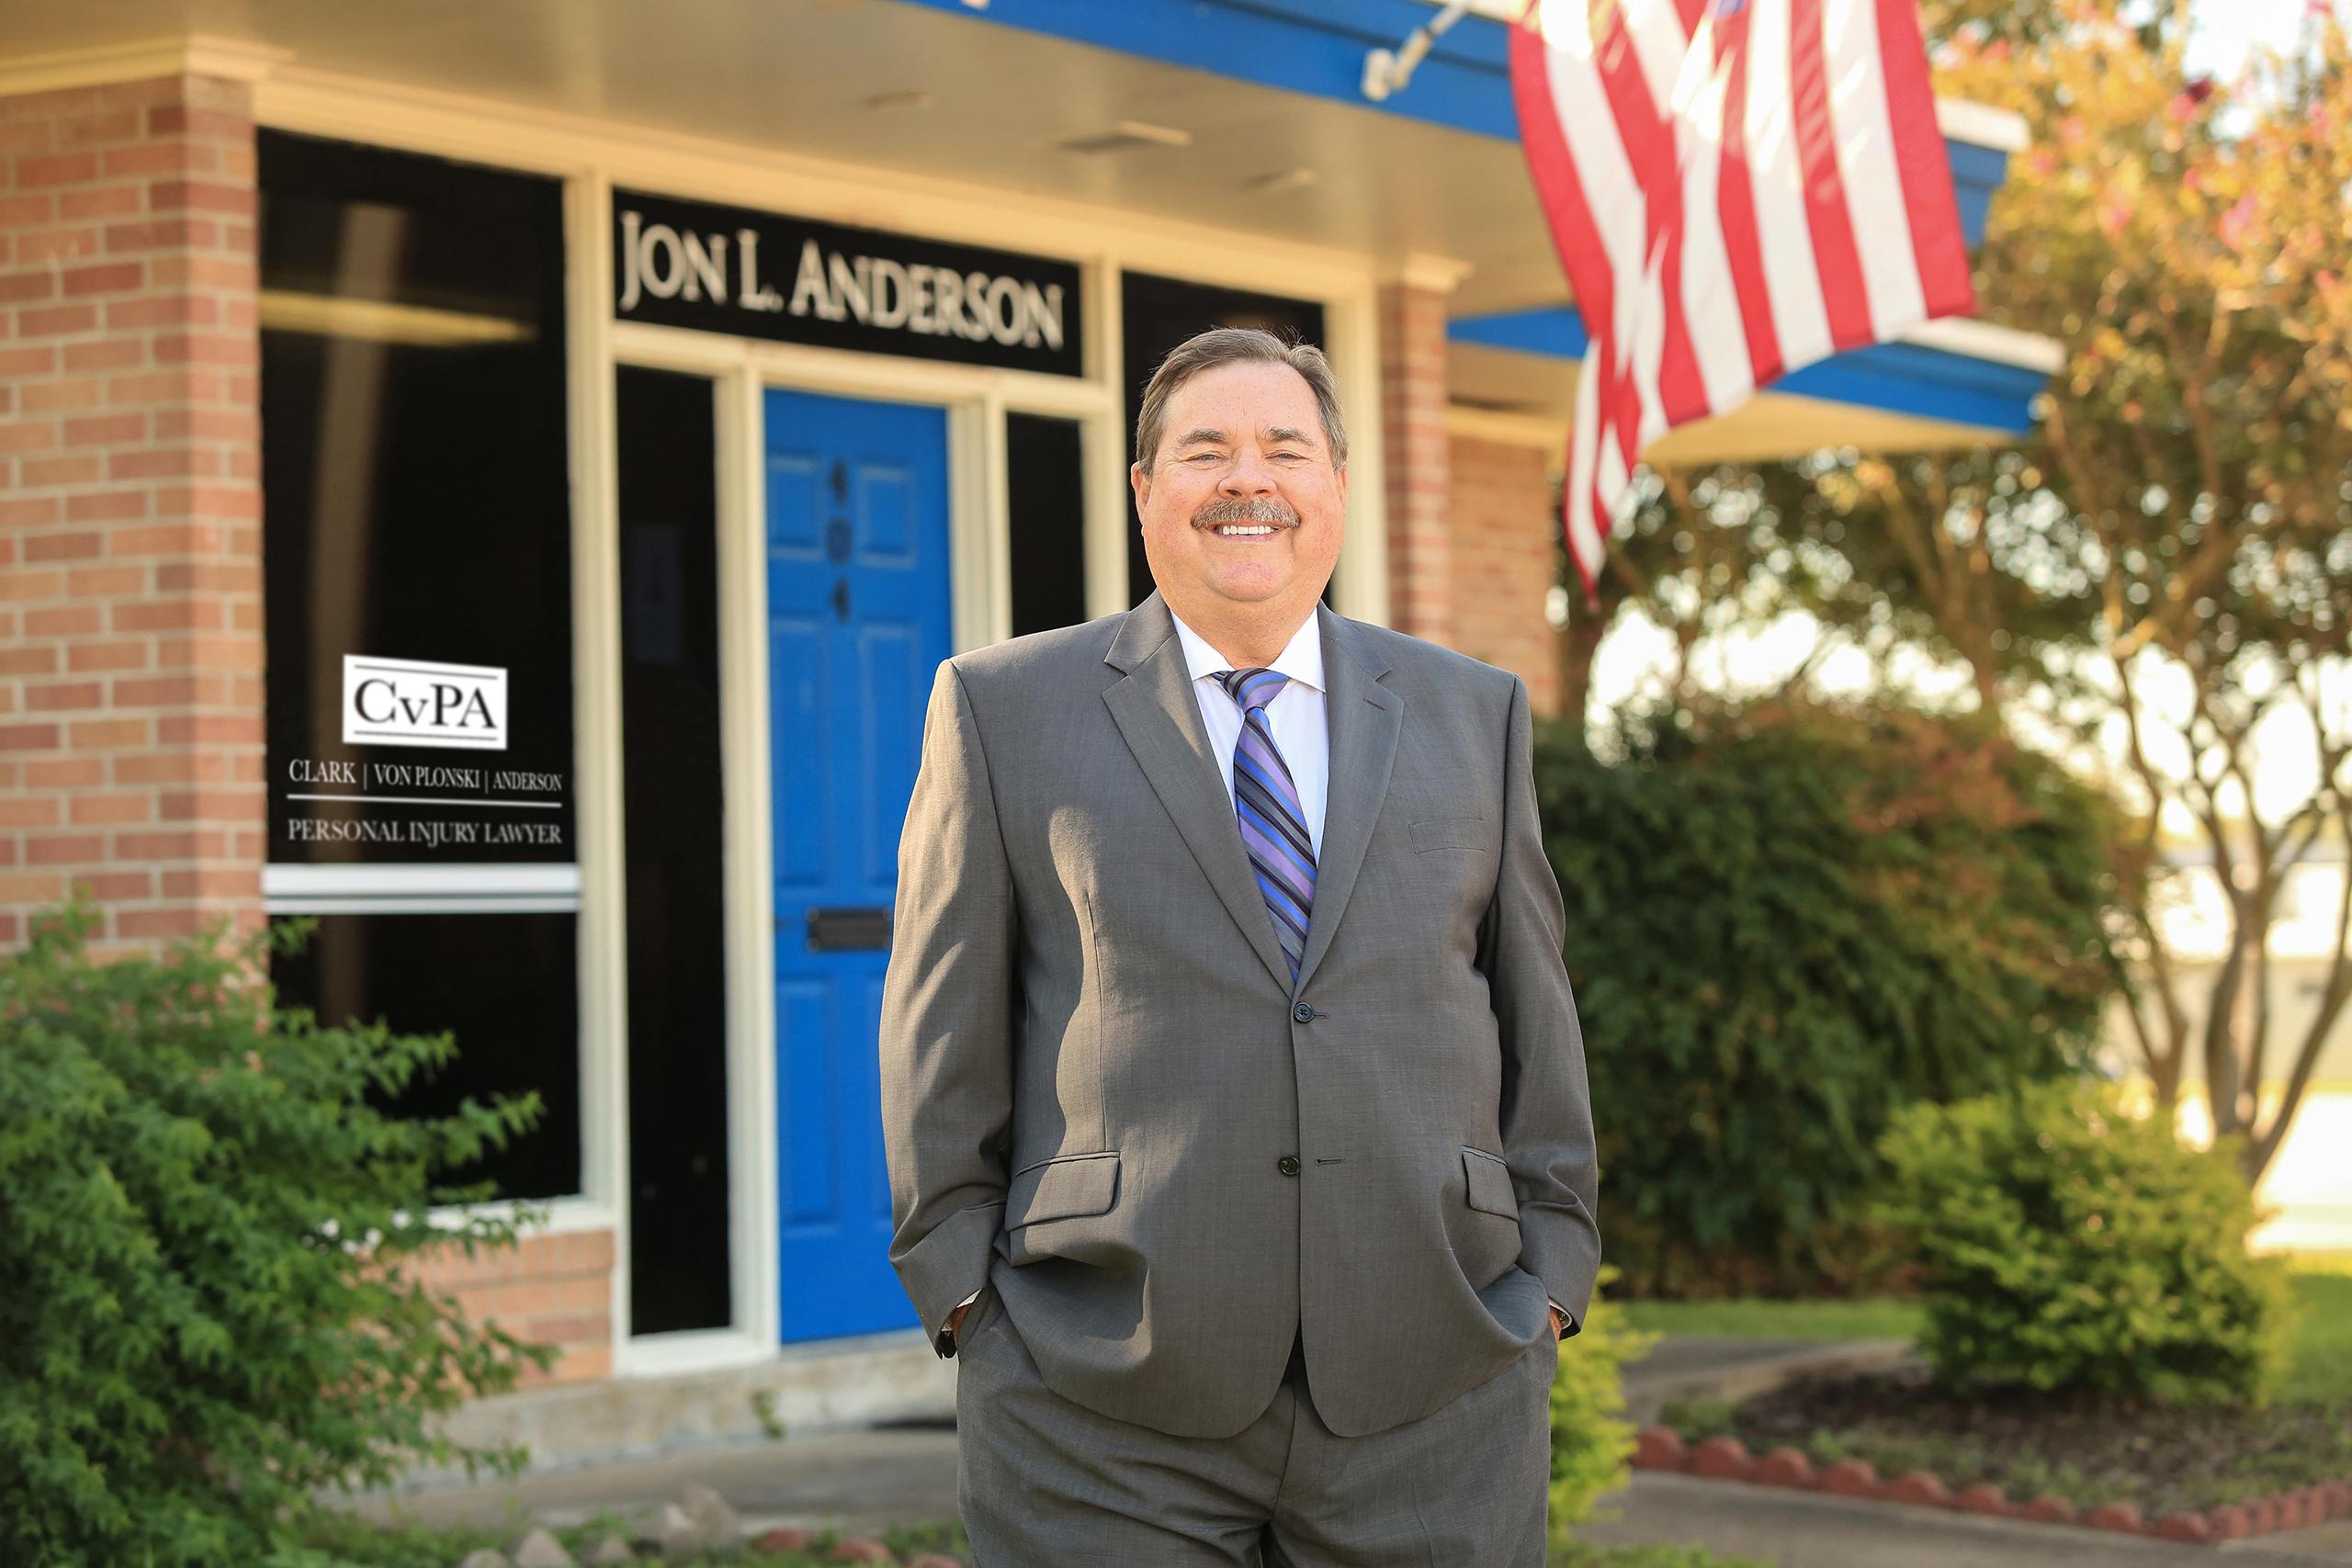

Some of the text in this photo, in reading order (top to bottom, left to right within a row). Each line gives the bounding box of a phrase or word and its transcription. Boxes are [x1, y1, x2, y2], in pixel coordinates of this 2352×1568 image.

[620, 210, 1064, 351] JON L. ANDERSON
[354, 678, 497, 729] CvPA
[288, 759, 562, 792] CLARK VON PLONSKI ANDERSON
[288, 818, 563, 848] PERSONAL INJURY LAWYER
